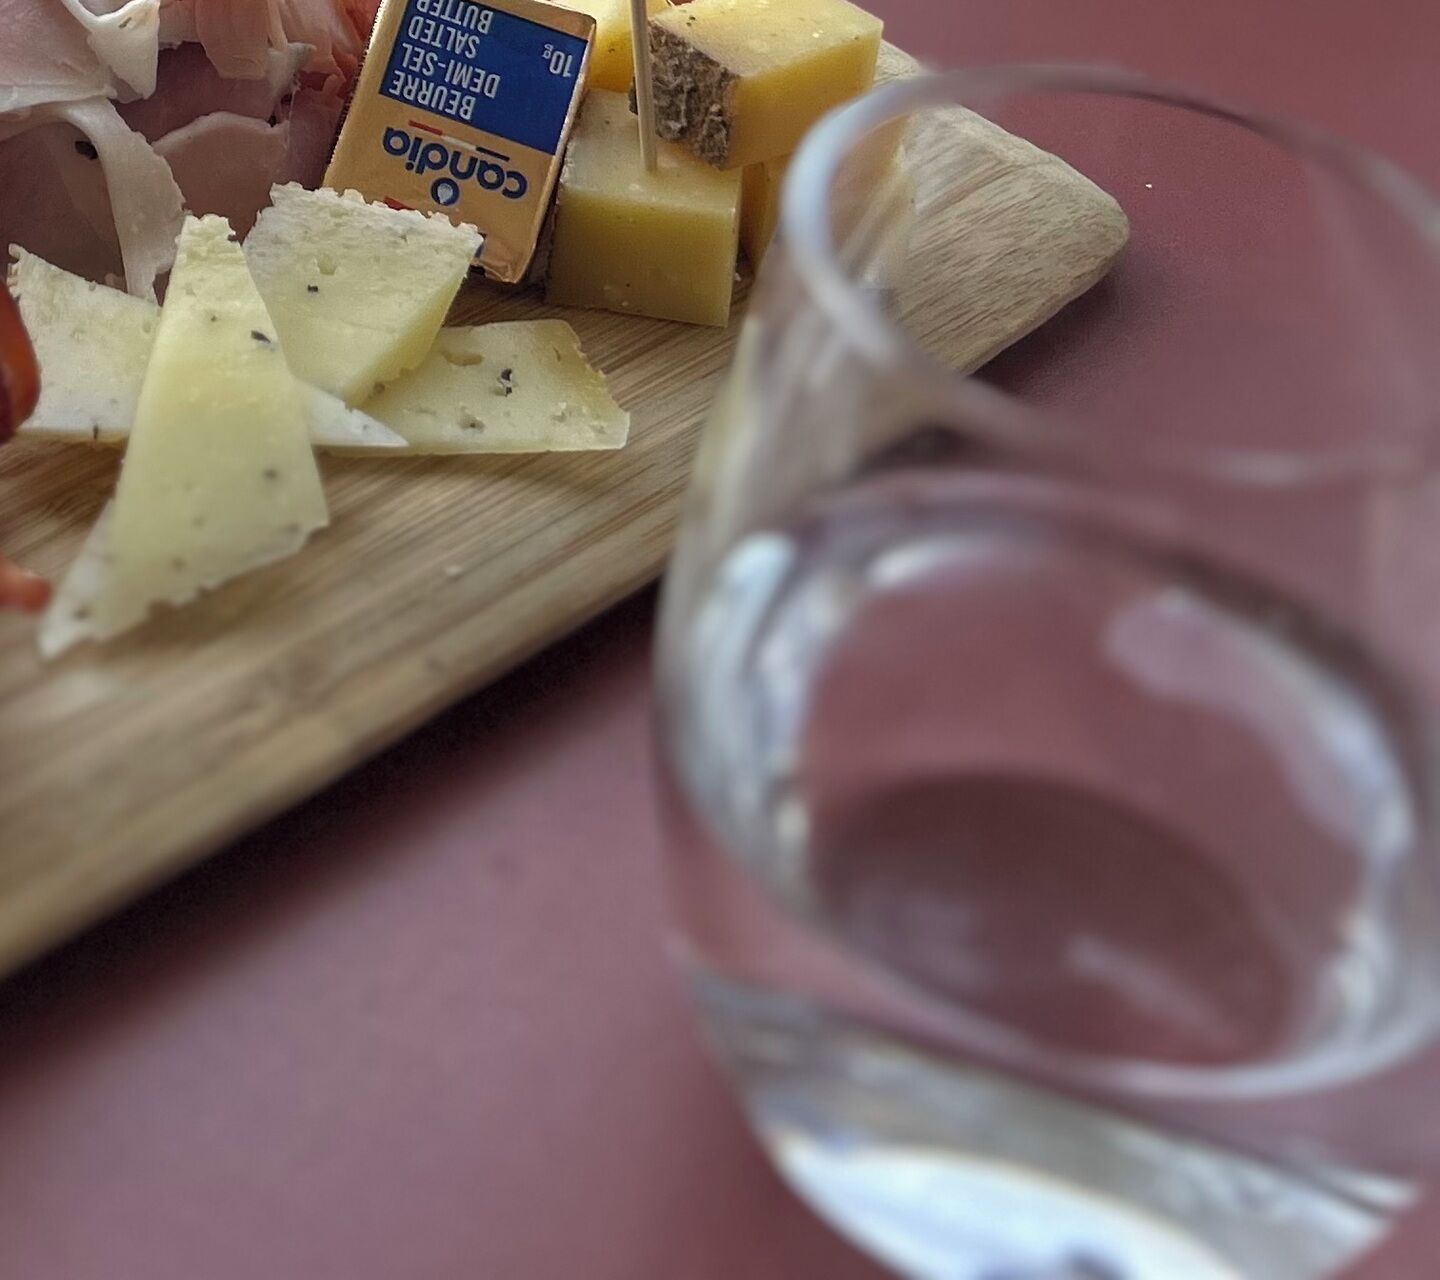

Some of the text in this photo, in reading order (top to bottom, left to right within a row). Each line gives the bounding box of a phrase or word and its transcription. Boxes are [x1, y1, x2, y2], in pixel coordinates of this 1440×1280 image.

[408, 16, 481, 59] SALTED
[541, 43, 574, 78] 10g
[388, 70, 477, 121] BEURRE
[401, 42, 501, 99] DEMI-SEL
[382, 126, 528, 199] candia
